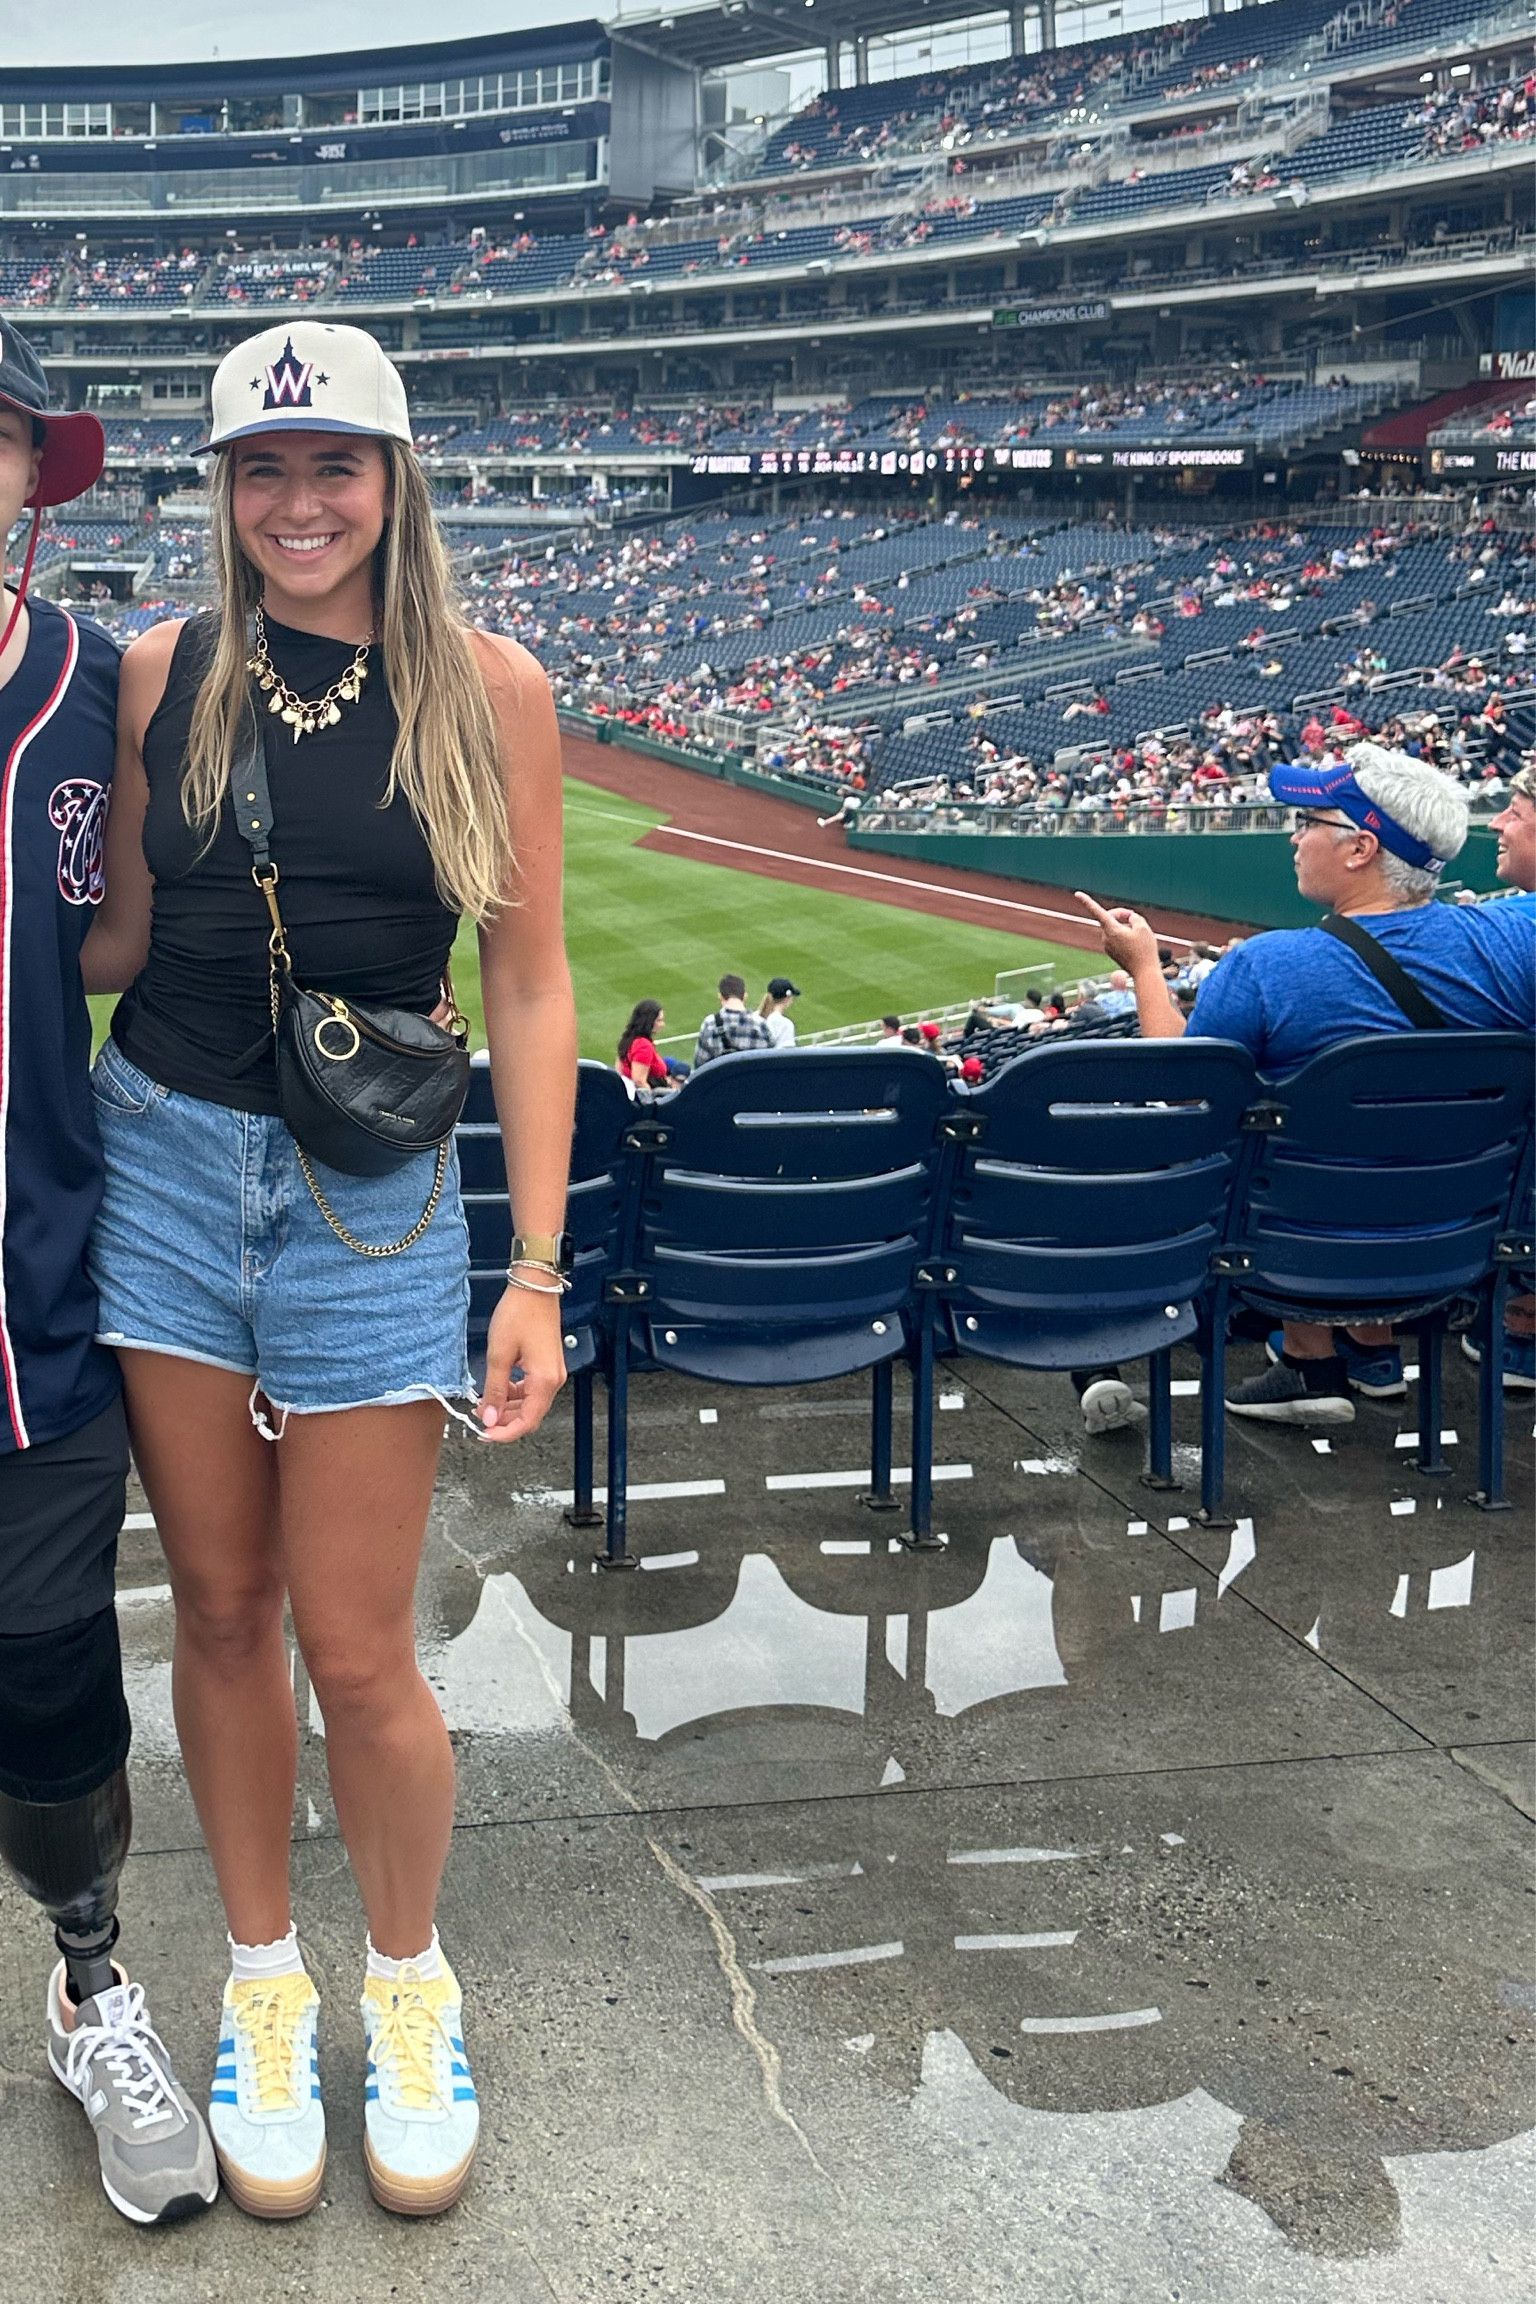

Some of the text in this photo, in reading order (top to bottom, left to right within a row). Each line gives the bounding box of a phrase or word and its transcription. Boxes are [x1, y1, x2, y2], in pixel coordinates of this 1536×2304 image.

[1018, 306, 1076, 325] CHAMPIONS
[1078, 304, 1105, 319] CLUB
[265, 362, 314, 404] W
[898, 453, 909, 470] 0
[926, 453, 937, 469] 0
[1112, 449, 1244, 466] THE KING OF SPORTSBOOKS
[1496, 451, 1520, 470] THE
